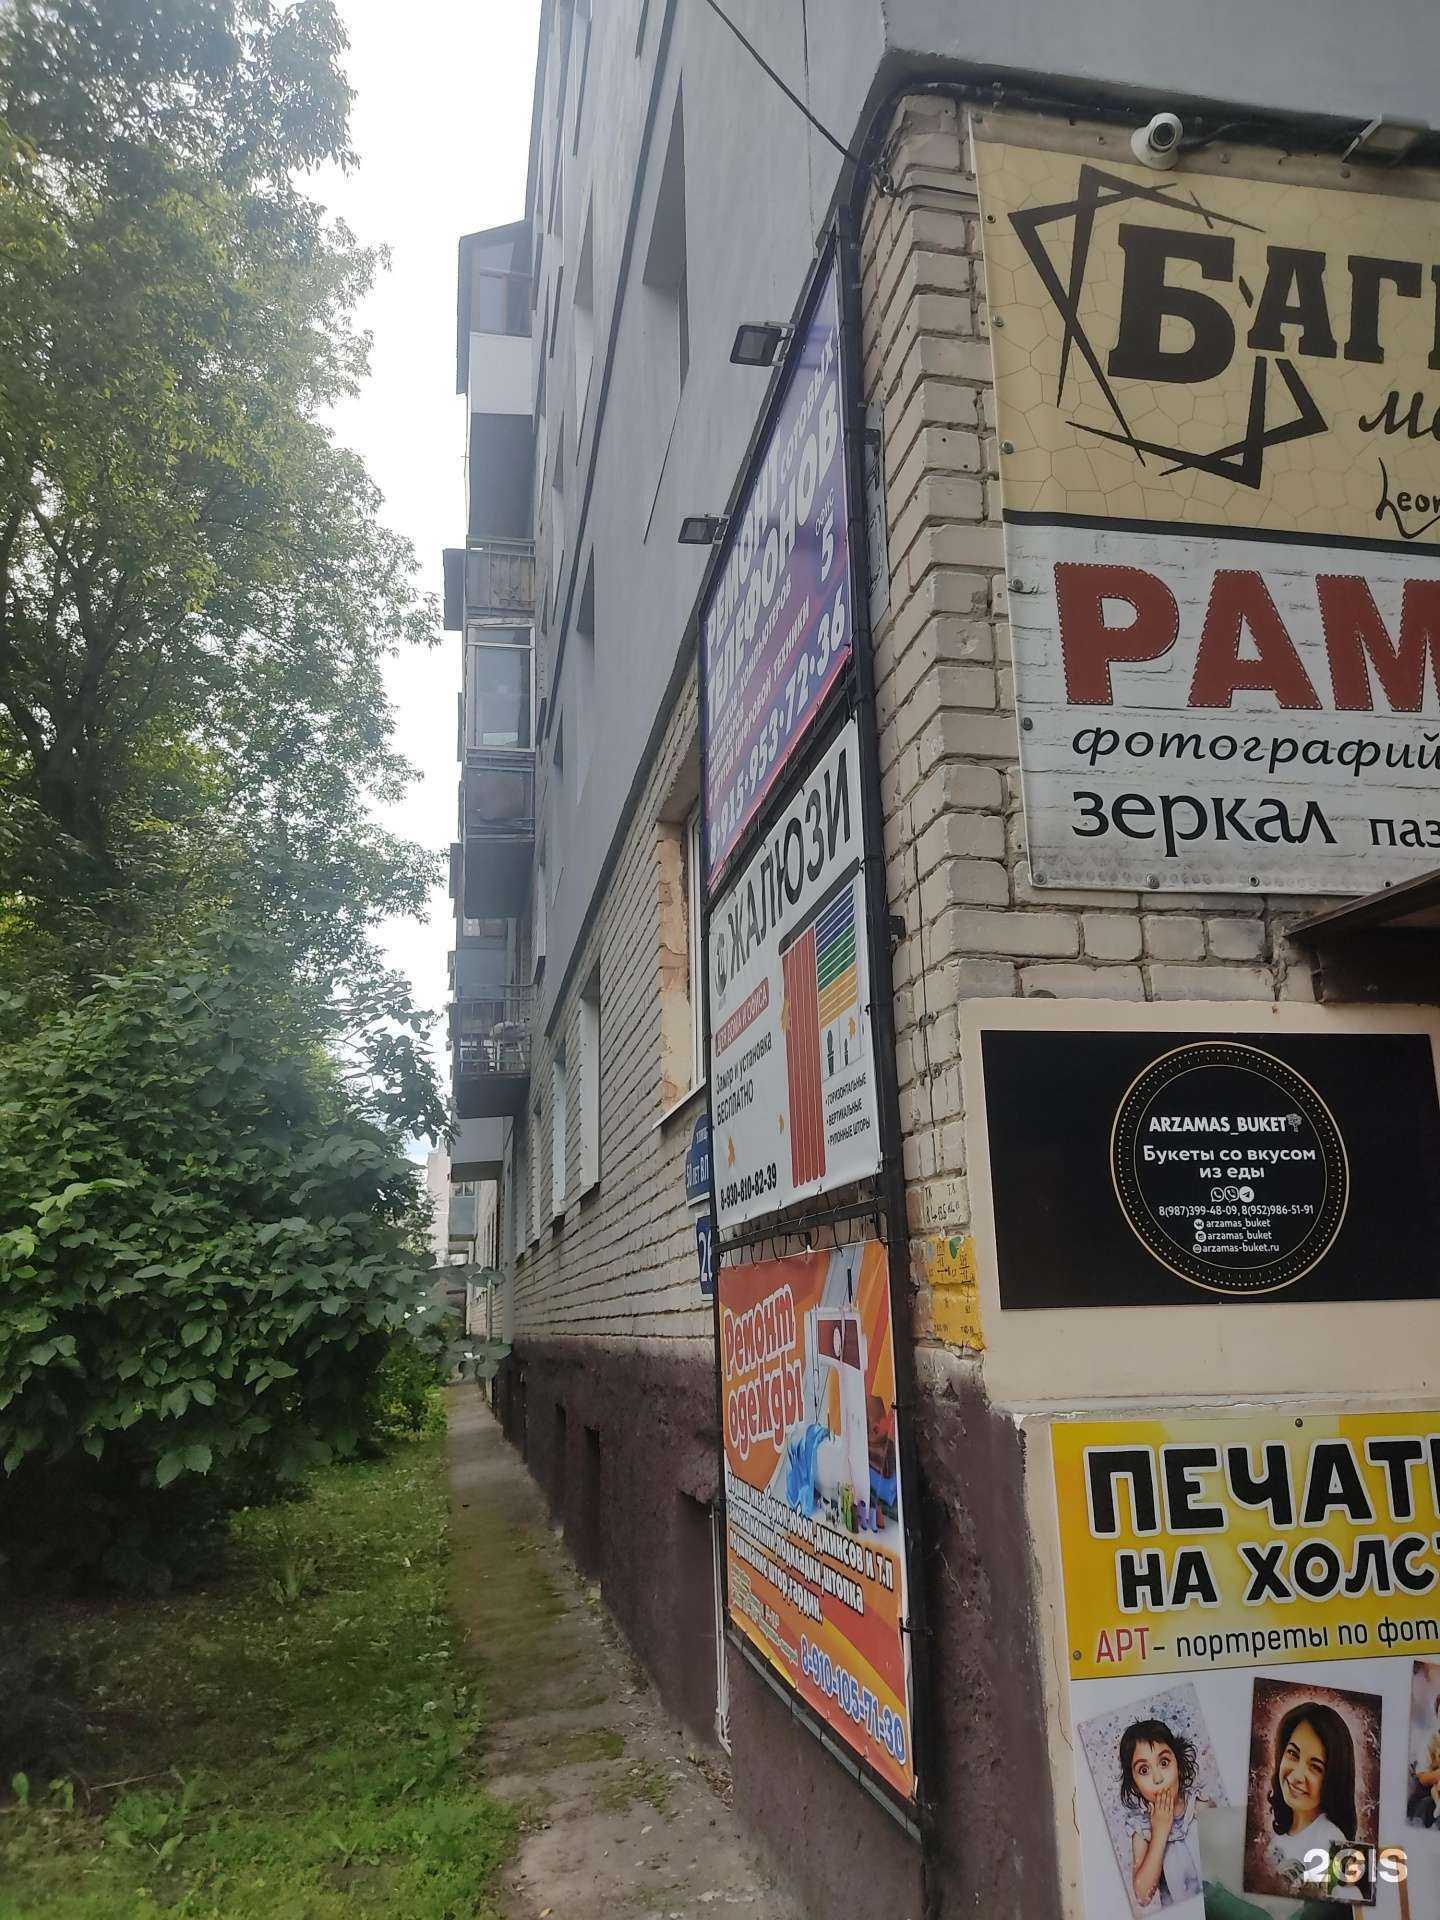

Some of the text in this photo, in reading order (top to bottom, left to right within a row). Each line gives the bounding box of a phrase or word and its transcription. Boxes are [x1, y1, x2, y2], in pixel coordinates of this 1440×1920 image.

[1107, 223, 1440, 383] БАГ
[707, 427, 782, 674] РЕМОНТ
[707, 380, 838, 734] ТЕЛЕФОНОВ
[820, 512, 834, 583] 5
[774, 594, 809, 681] ТЕХНИКИ
[1072, 727, 1440, 777] фотографий
[1071, 791, 1338, 857] зеркал
[727, 747, 851, 980] ЖАЛЮЗИ
[739, 1031, 772, 1081] установка
[717, 1079, 754, 1126] БЕСПЛАТНО
[1149, 1116, 1287, 1135] ARZAMAS_BUKET
[720, 1159, 776, 1212] 8-930-810-82-39
[1143, 1145, 1316, 1164] Букеты со вкусом
[1199, 1166, 1265, 1180] из еды
[1206, 1218, 1271, 1230] arzamas_buket
[1207, 1231, 1272, 1242] arzamas_buket
[722, 1283, 796, 1381] Ремонт
[727, 1354, 805, 1461] одежды
[1087, 1438, 1440, 1534] ПЕЧАТ
[1120, 1537, 1440, 1609] НА ХОЛС
[1177, 1625, 1329, 1662] портреты
[1338, 1622, 1367, 1646] по
[801, 1632, 906, 1766] 8-910-105-71-30
